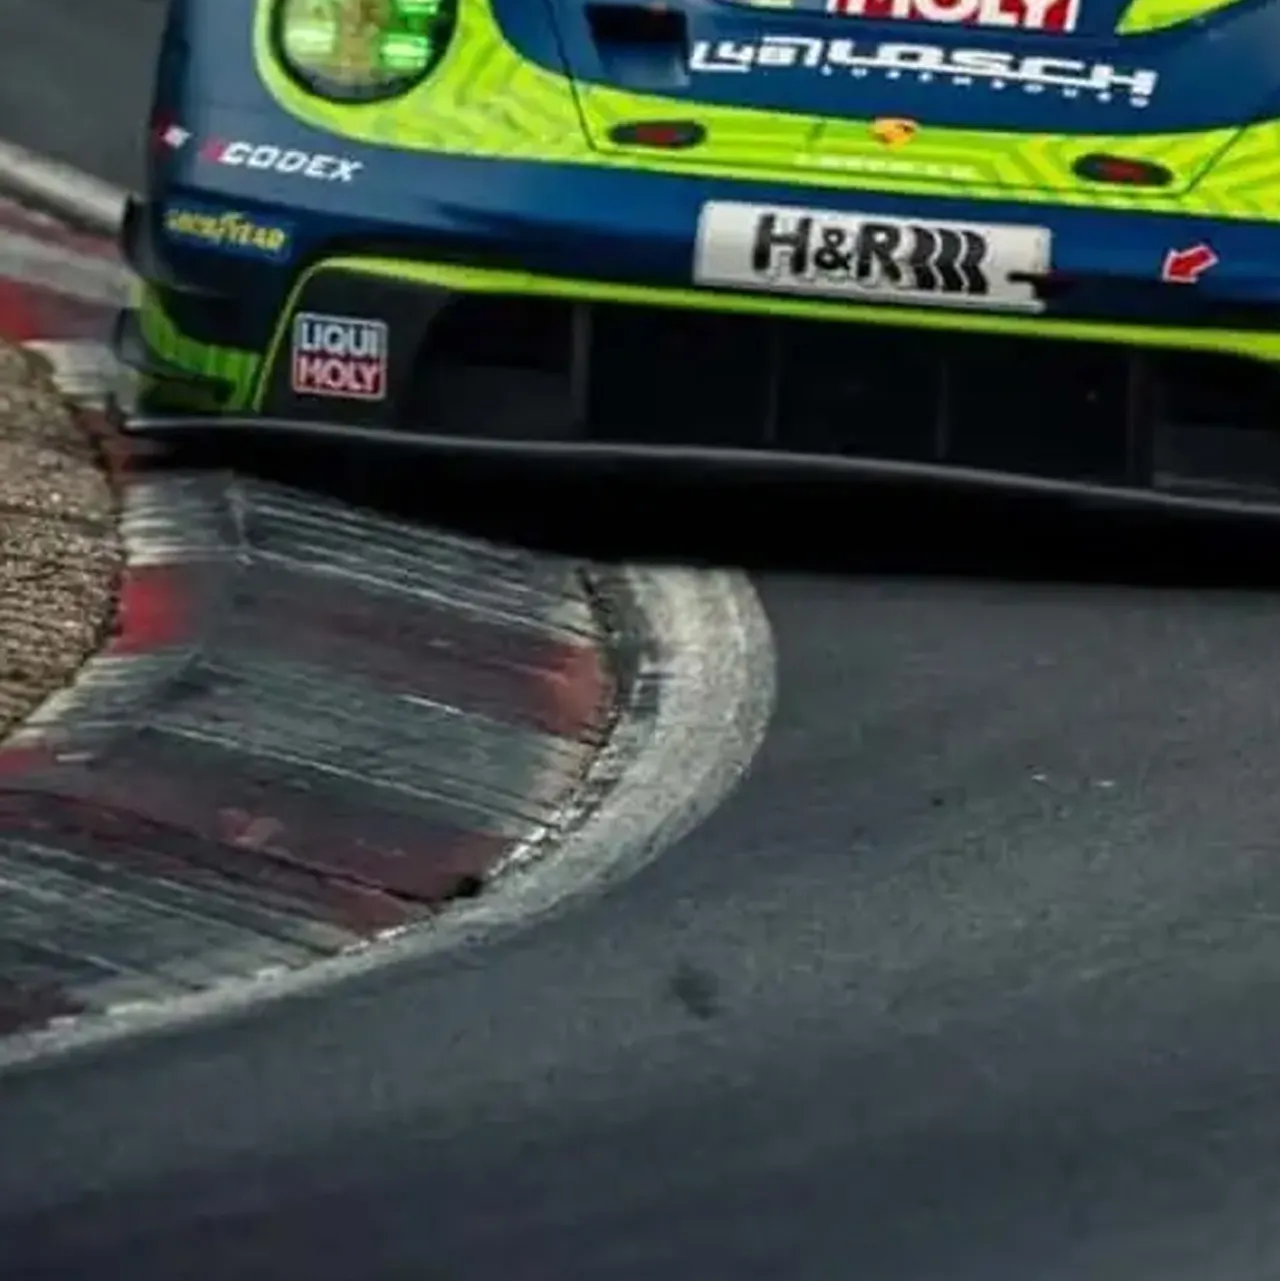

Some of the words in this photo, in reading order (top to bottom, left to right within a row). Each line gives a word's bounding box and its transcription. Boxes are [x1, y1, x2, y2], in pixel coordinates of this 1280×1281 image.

[218, 141, 364, 182] CODEX
[300, 320, 380, 359] LIQUI
[299, 356, 381, 394] MOLY
